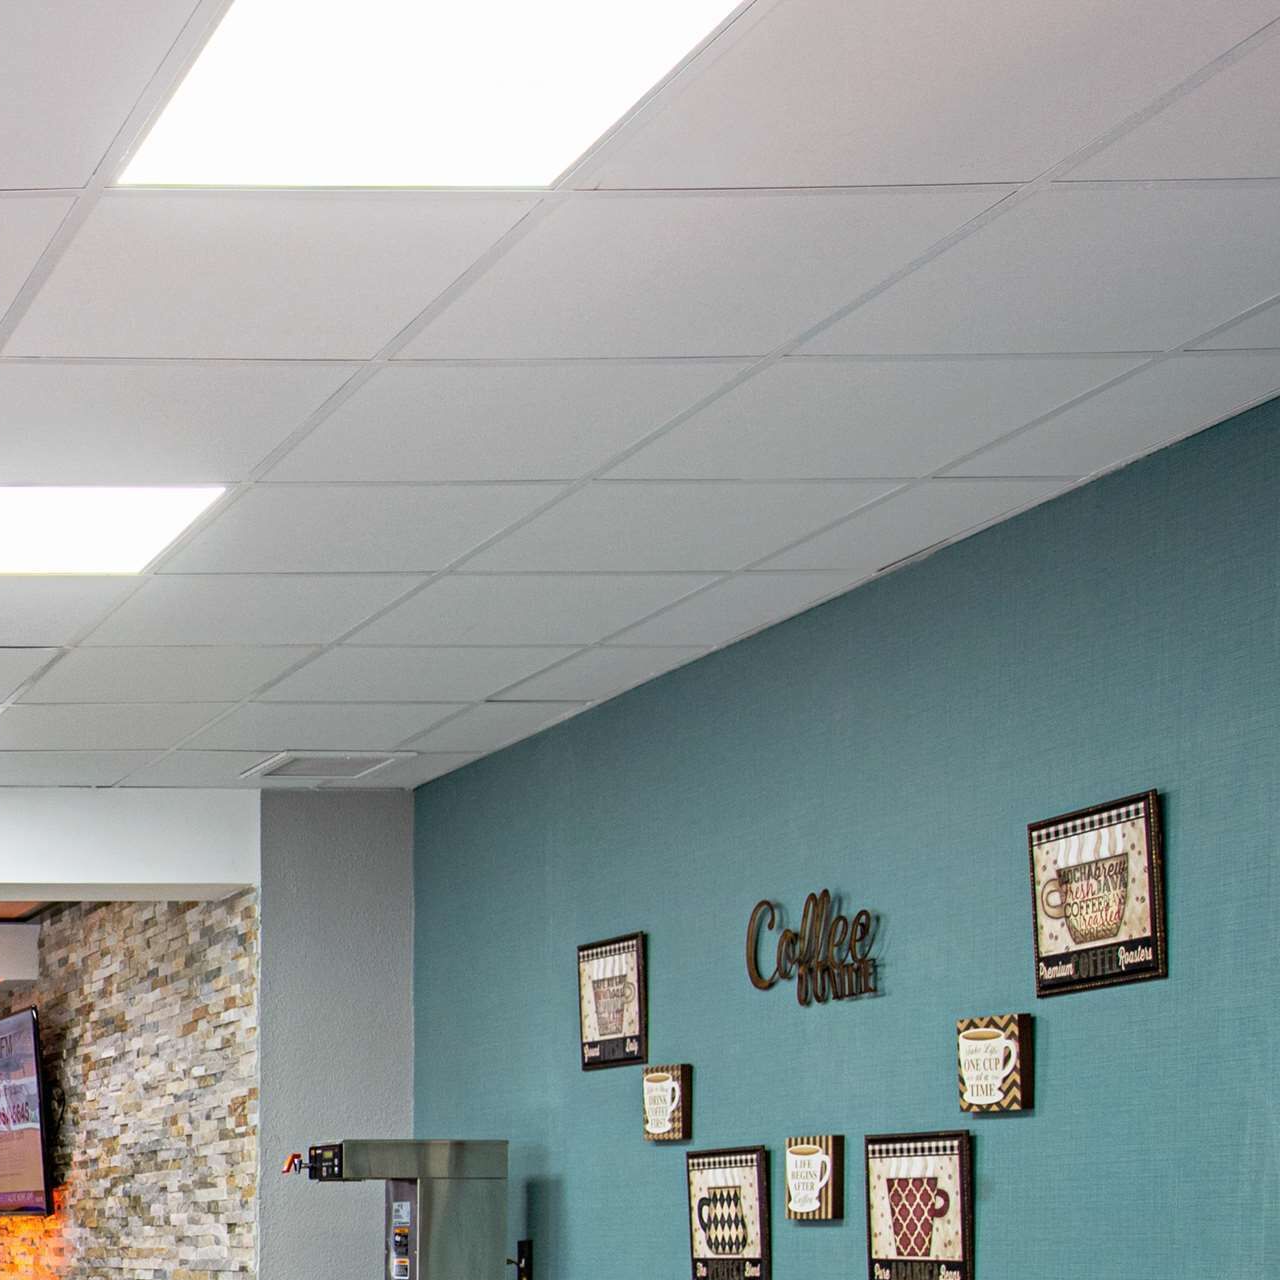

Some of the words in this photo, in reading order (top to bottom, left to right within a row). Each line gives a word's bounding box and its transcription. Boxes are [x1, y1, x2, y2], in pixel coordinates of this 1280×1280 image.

[1064, 896, 1104, 918] COFFEE
[746, 888, 877, 1005] Coffee
[1039, 960, 1074, 979] Premium
[1118, 945, 1153, 971] Roasters
[964, 1058, 981, 1072] ONE
[983, 1057, 1000, 1071] CUP
[969, 1084, 996, 1097] TIME
[791, 1171, 817, 1180] BEGINS
[793, 1182, 815, 1191] AFTER
[874, 1263, 890, 1280] Pure
